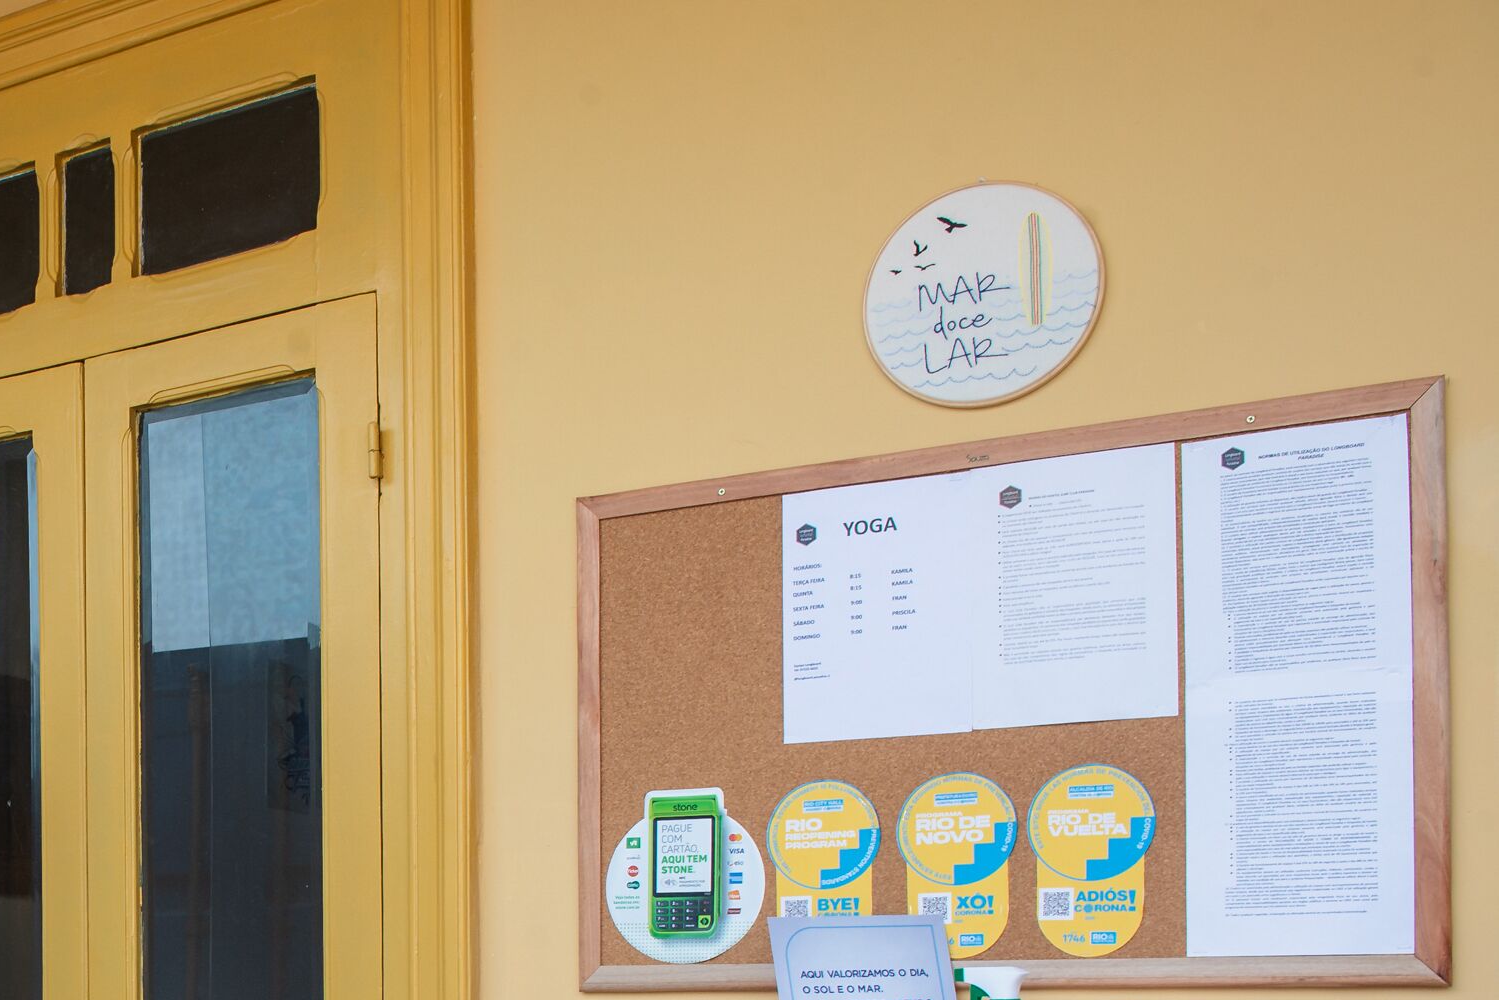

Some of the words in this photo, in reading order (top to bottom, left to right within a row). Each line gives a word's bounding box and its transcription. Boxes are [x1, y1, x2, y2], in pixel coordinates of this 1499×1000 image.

[918, 272, 1010, 312] MAR
[933, 306, 993, 340] doce
[924, 337, 1009, 374] LAR
[843, 517, 898, 537] YOGA
[793, 633, 821, 641] DOMINGO
[673, 803, 698, 811] stone
[785, 818, 822, 832] RIO
[915, 817, 954, 831] RIO
[959, 815, 991, 830] DE
[1047, 814, 1081, 826] RIO
[1088, 812, 1116, 825] DE
[661, 823, 692, 833] PAGUE
[1048, 823, 1128, 837] VUELTA
[1136, 817, 1152, 849] COVID-19
[661, 834, 683, 843] COM
[785, 830, 856, 841] REOPENING
[915, 829, 984, 846] NOVO
[1001, 822, 1014, 852] COVID-19
[785, 840, 847, 849] PROGRAM
[661, 855, 685, 864] AQUI
[687, 854, 708, 863] TEM
[817, 897, 860, 916] BYE!
[956, 893, 994, 914] XÔ!
[1076, 888, 1136, 911] ADIÓS!
[801, 970, 823, 979] AQUI
[827, 969, 895, 979] VALORIZAMOS
[898, 969, 907, 977] O
[909, 968, 929, 978] DIA,
[802, 986, 811, 994] O
[813, 985, 835, 994] SOL
[837, 985, 844, 993] E
[847, 985, 855, 993] O
[858, 985, 883, 993] MAR.
